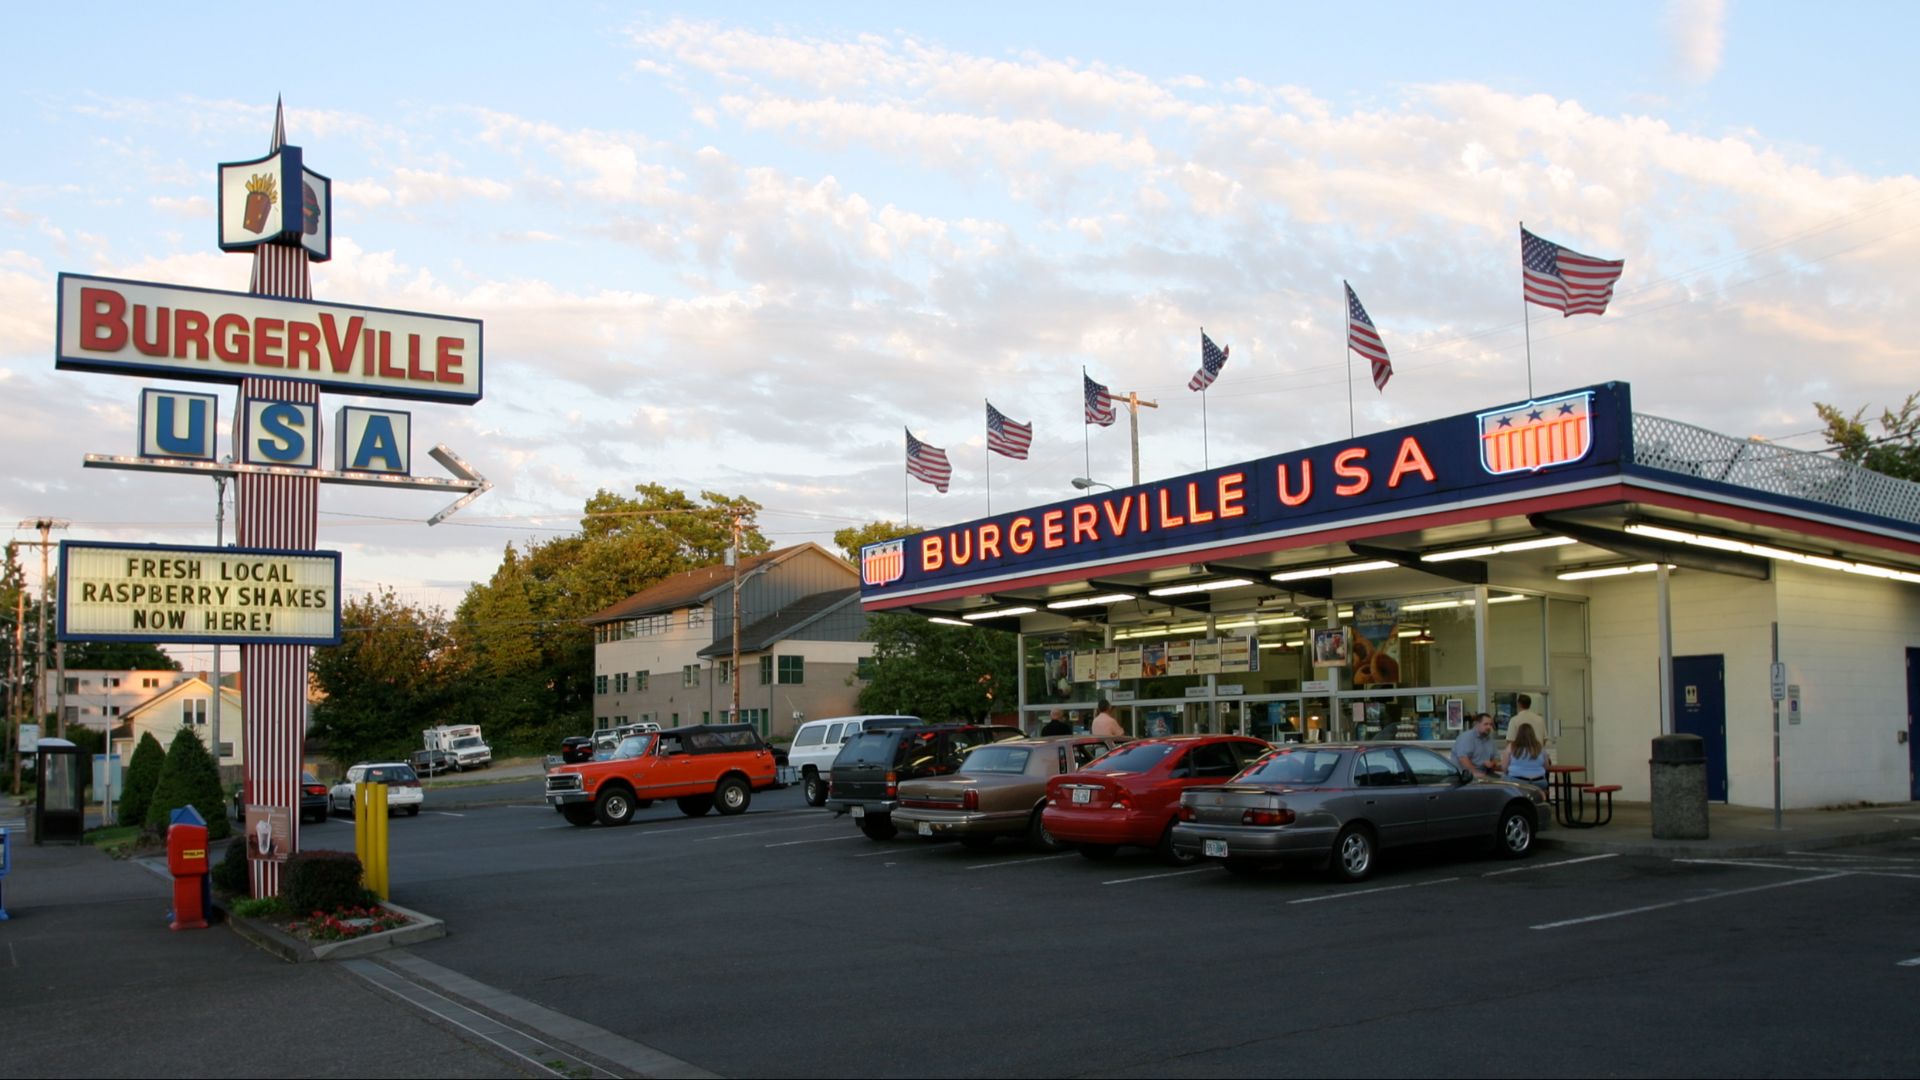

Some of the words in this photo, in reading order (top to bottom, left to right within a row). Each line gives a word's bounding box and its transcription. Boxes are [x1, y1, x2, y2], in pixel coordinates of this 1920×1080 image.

[921, 471, 1246, 573] BURGERVILLE
[127, 557, 202, 580] FRESH
[220, 560, 294, 583] LOCAL
[82, 582, 230, 606] RASPBERRY
[237, 586, 327, 609] SHAKES
[132, 609, 187, 630] NOW
[204, 611, 273, 632] HERE!
